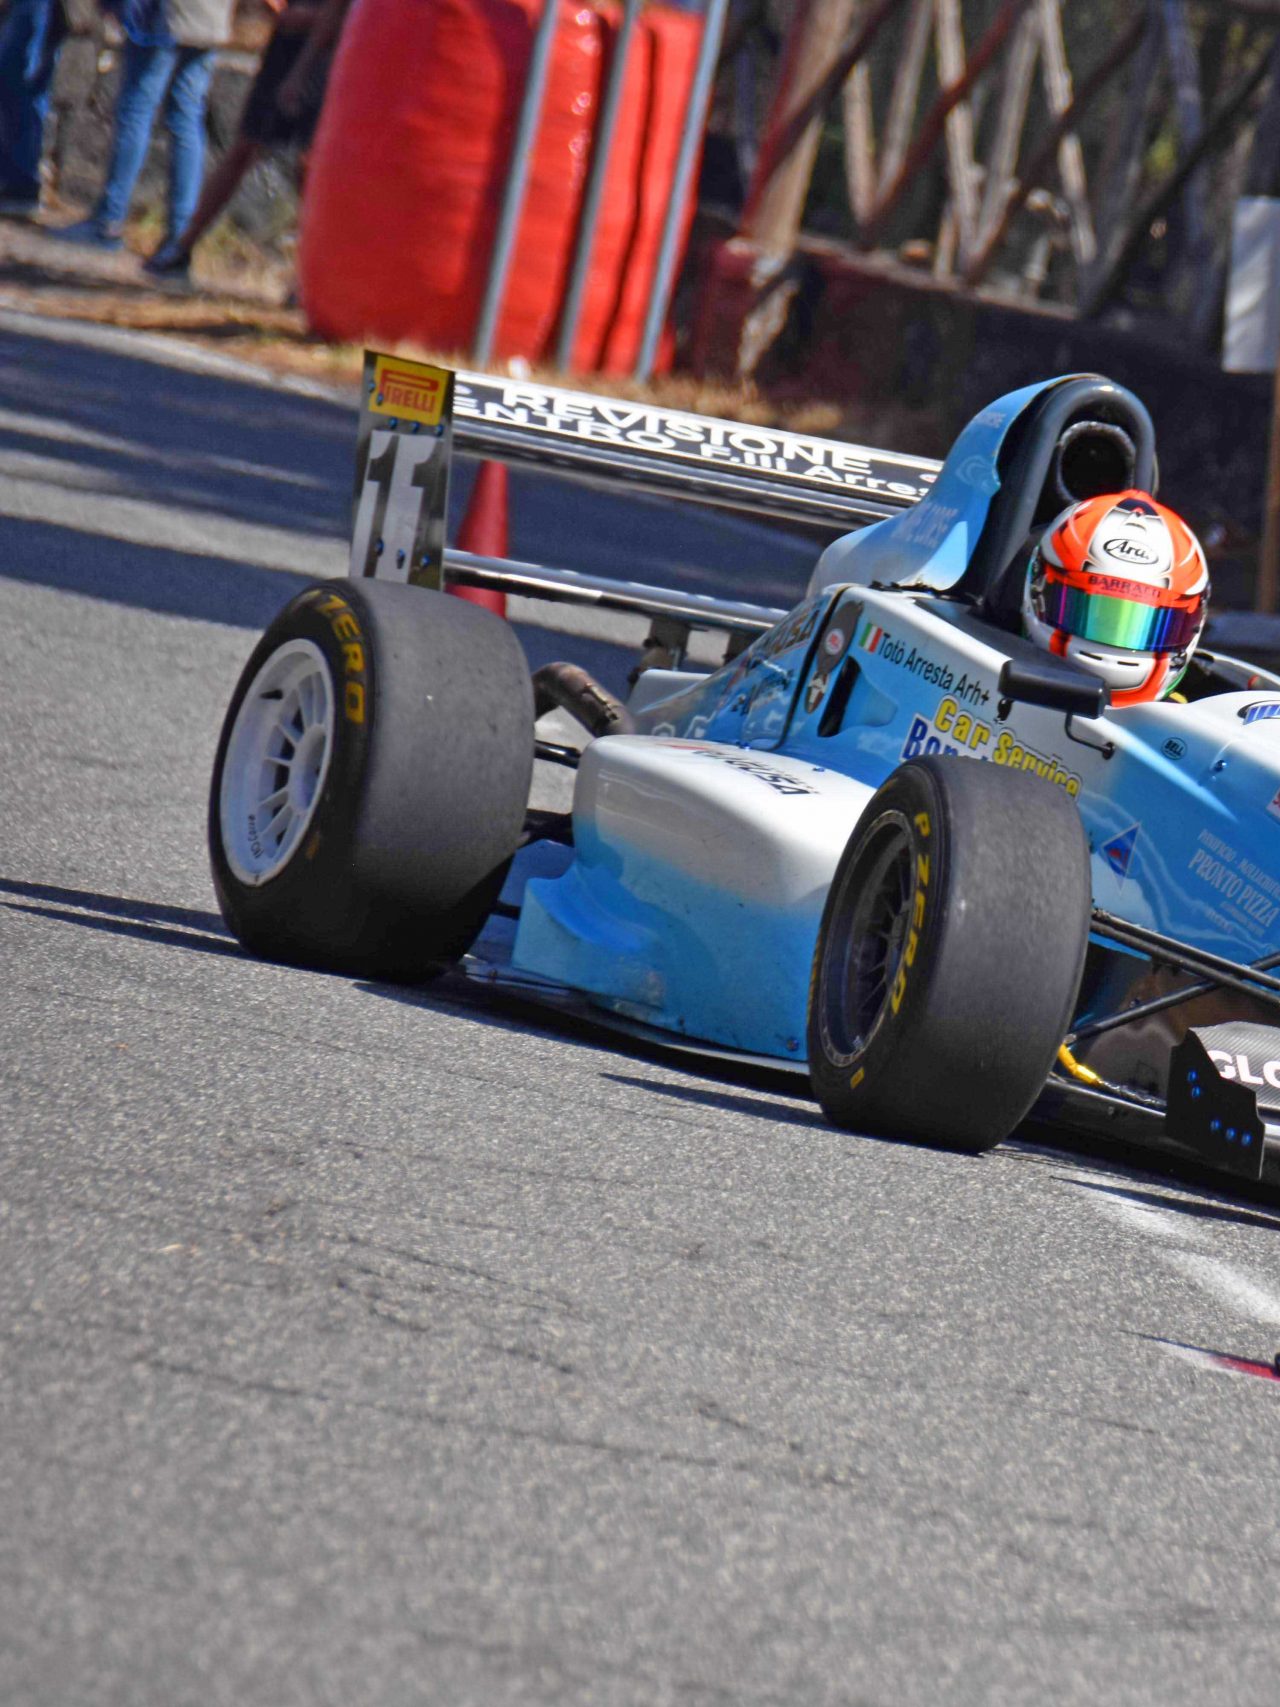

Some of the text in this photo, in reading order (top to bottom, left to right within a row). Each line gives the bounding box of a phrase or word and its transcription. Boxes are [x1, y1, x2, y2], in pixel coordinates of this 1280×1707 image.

[380, 368, 440, 412] PIRELLI
[503, 386, 872, 475] REVISIONE
[452, 396, 677, 451] ENTRO
[803, 464, 929, 497] Arres
[350, 429, 438, 584] 11
[315, 594, 366, 725] ZERO
[904, 647, 954, 690] Arresta
[934, 698, 991, 751] Car
[891, 853, 930, 1015] ZERO
